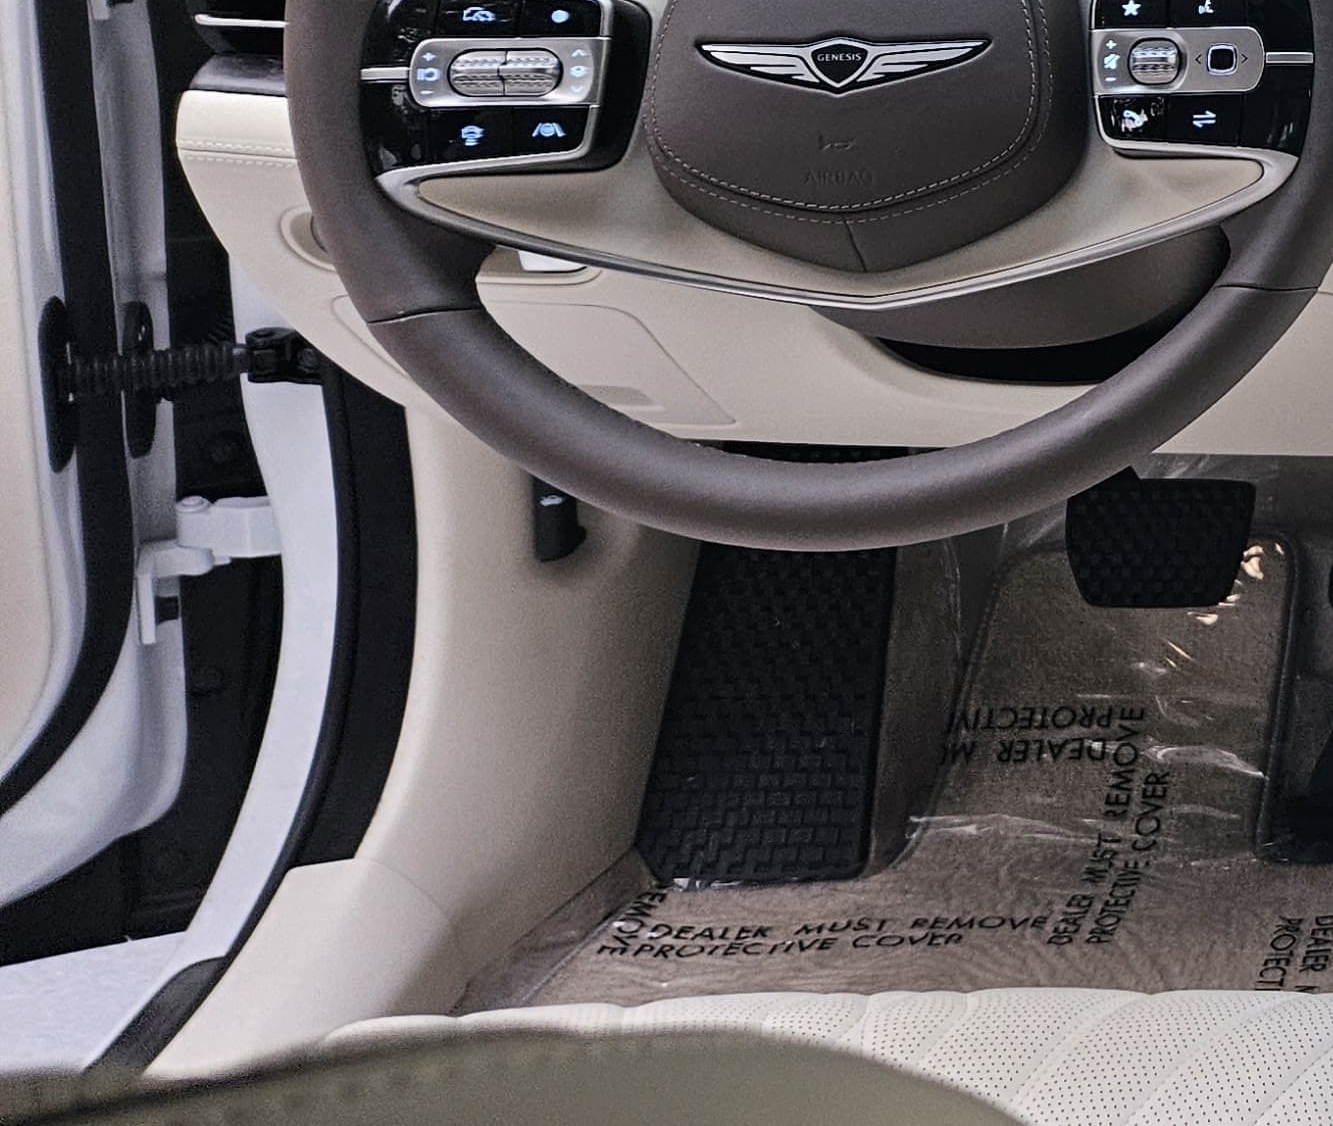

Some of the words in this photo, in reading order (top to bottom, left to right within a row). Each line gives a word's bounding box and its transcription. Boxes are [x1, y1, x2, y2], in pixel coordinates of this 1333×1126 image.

[817, 53, 862, 62] GENESIS
[997, 738, 1106, 763] DEALER
[1132, 771, 1170, 852] COVER
[648, 923, 773, 941] DEALER
[794, 916, 892, 936] MUST
[911, 915, 1050, 931] REMOVE
[1047, 893, 1094, 945] DEALER
[633, 937, 839, 959] PROTECTIVE
[852, 933, 963, 949] COVER
